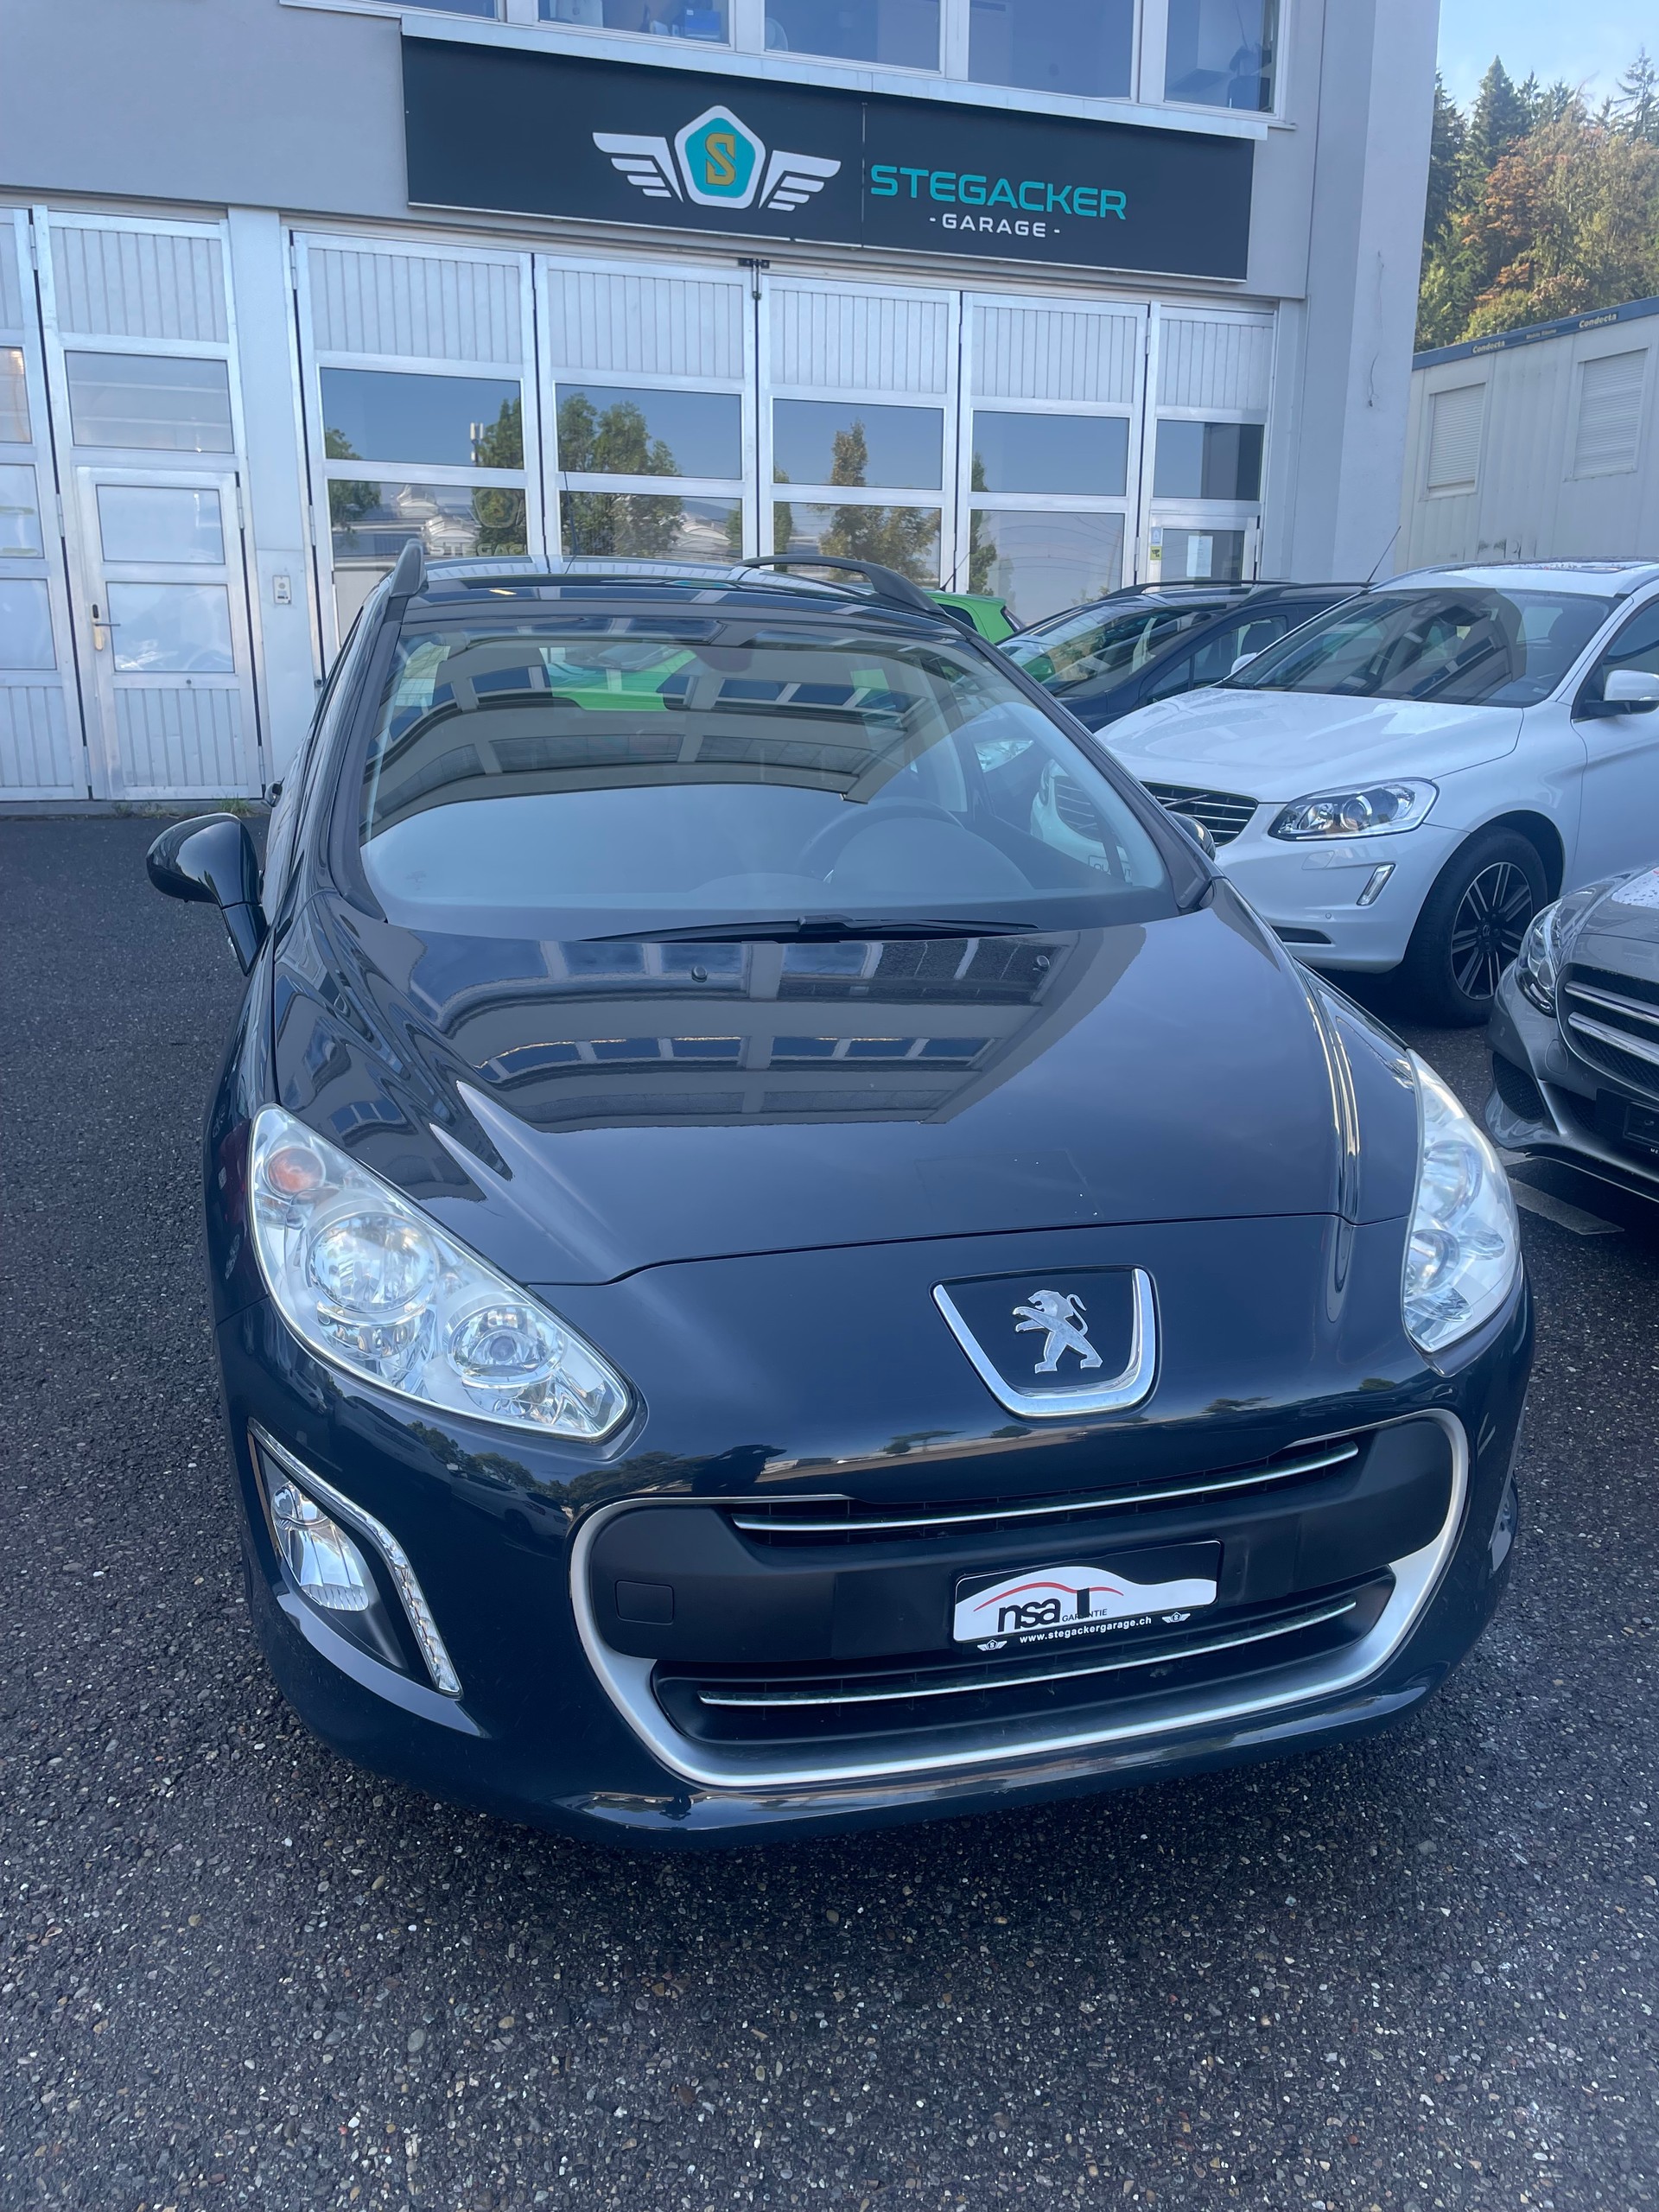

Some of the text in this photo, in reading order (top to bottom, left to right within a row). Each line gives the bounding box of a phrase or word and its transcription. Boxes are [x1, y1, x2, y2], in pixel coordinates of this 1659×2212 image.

[705, 132, 736, 186] S
[870, 164, 1127, 220] STEGACKER
[1579, 313, 1617, 328] Condecta
[1472, 340, 1505, 353] Condecta
[997, 1598, 1061, 1632] nsa
[1020, 1616, 1153, 1643] www.stegackergarage.ch
